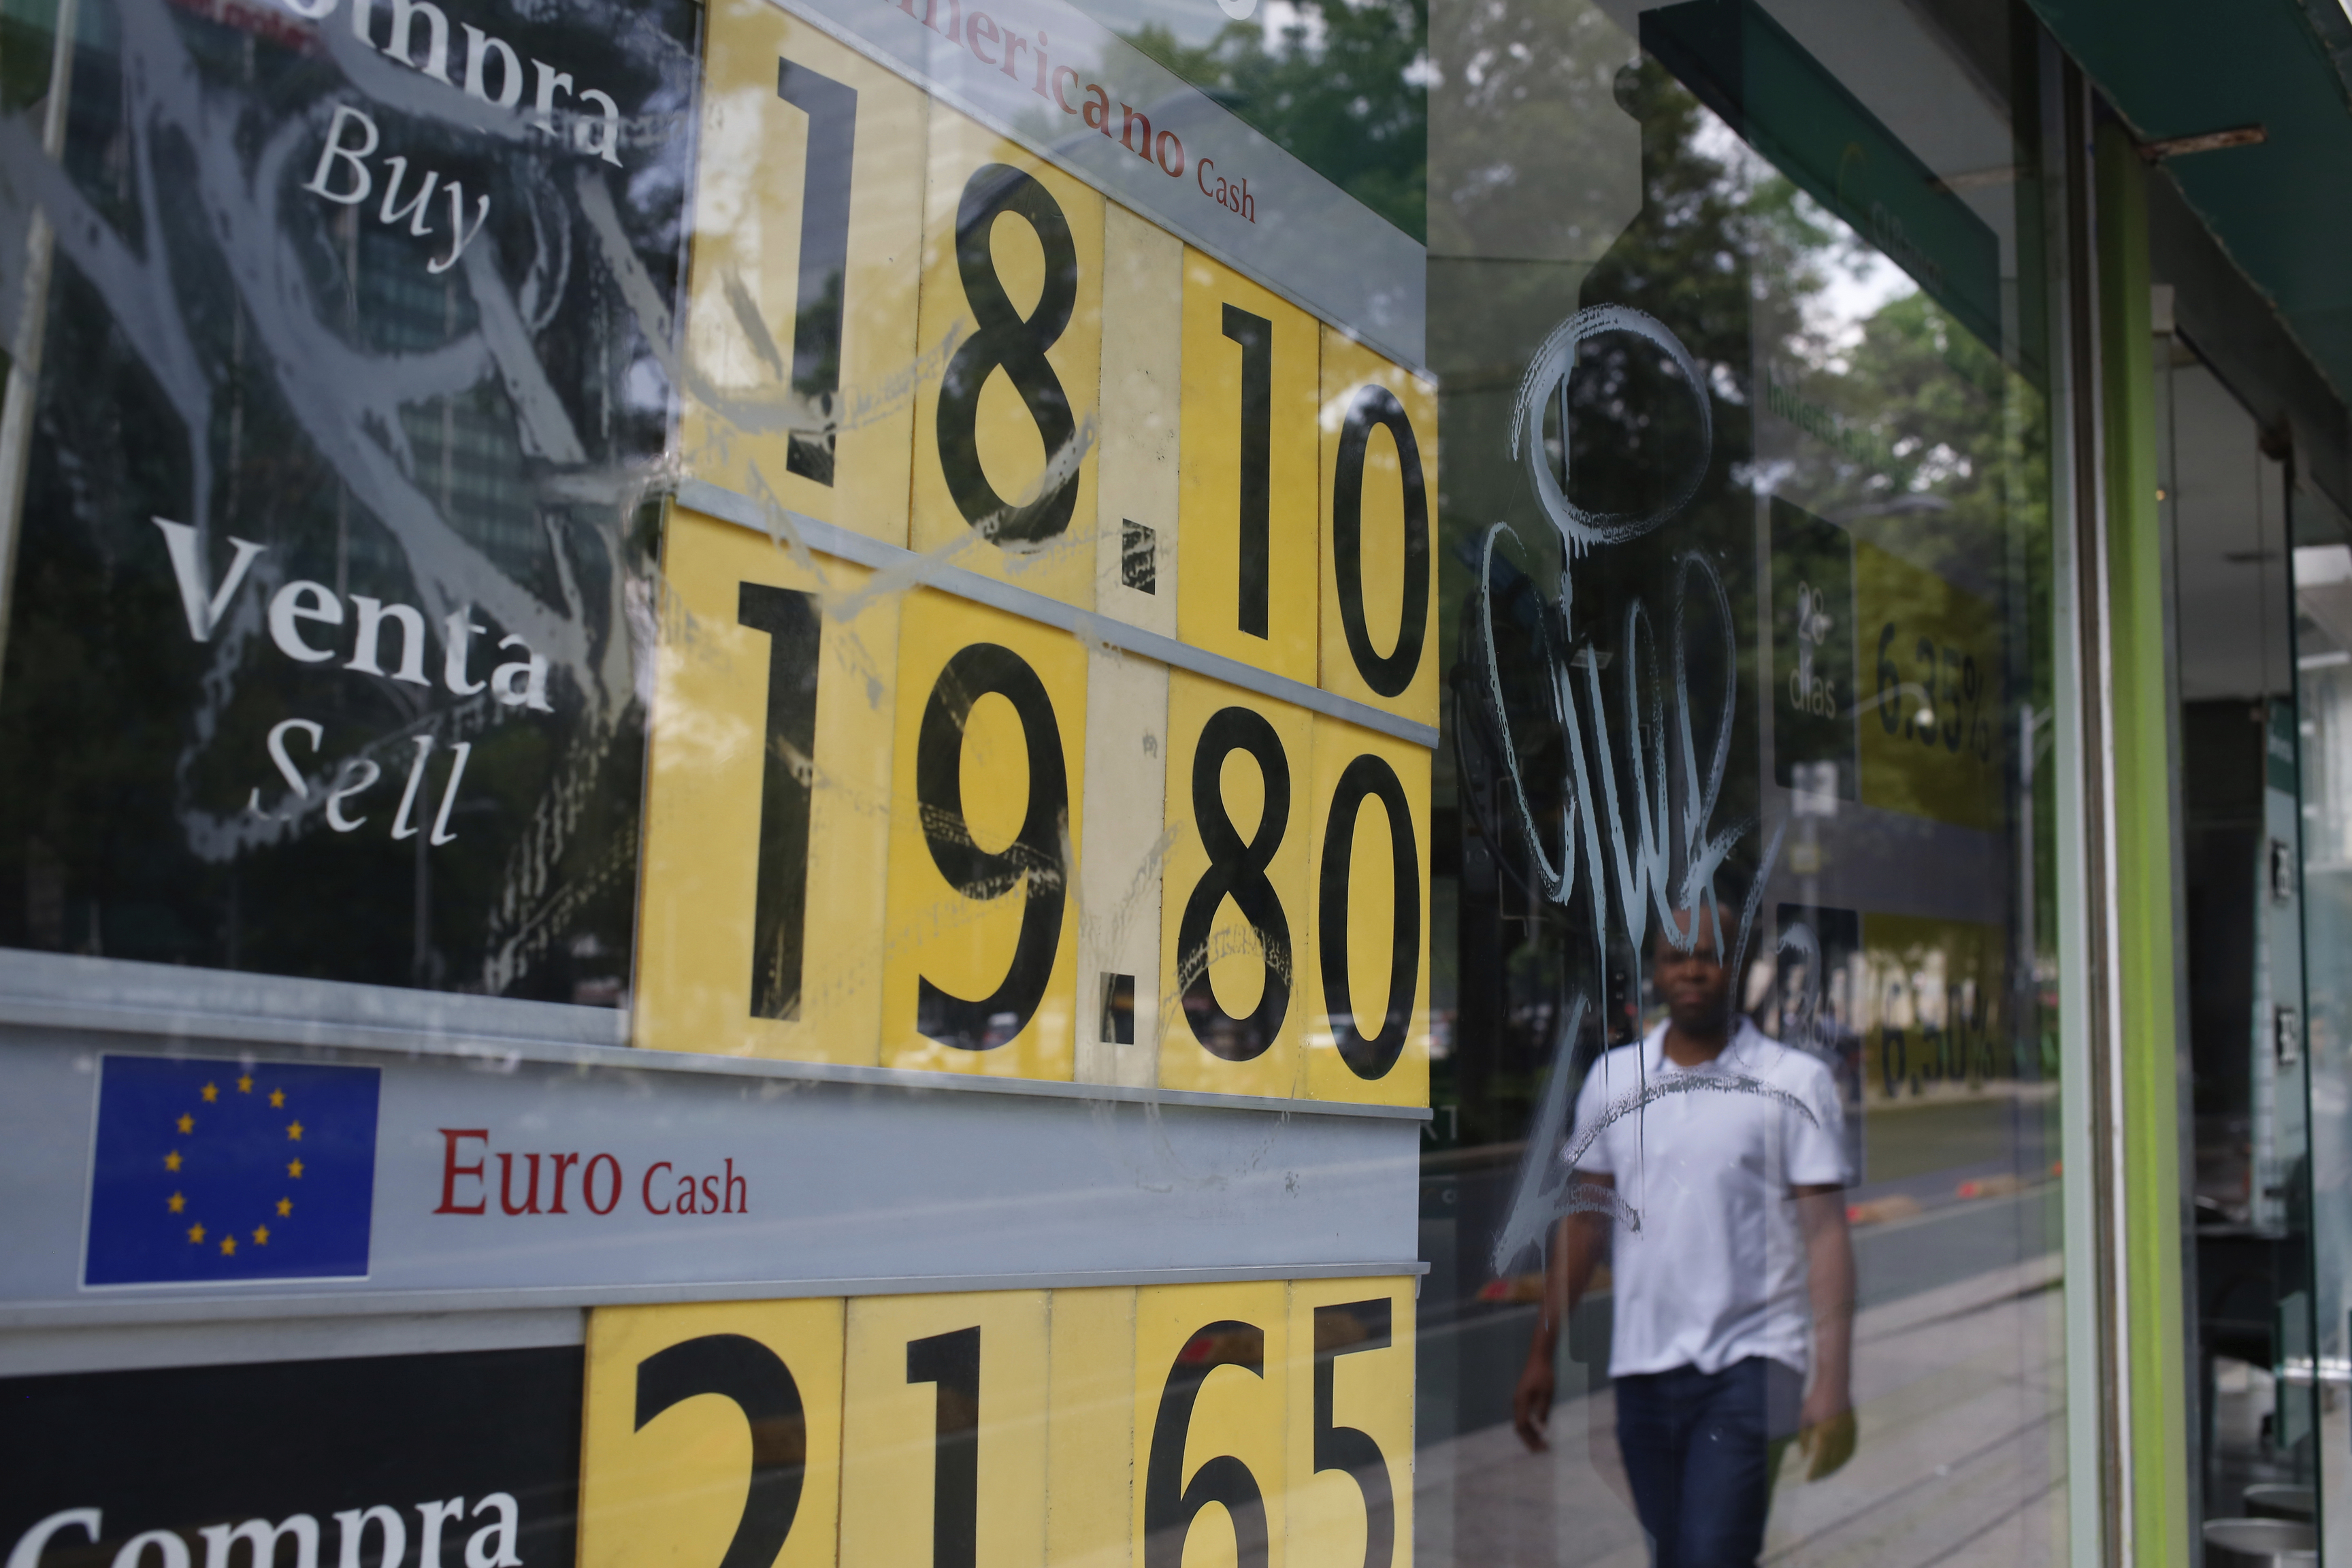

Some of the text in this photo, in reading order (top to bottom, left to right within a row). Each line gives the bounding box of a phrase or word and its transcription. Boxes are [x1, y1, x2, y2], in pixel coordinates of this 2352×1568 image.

[278, 0, 623, 168] mpra
[304, 104, 490, 274] Buy
[1197, 157, 1256, 224] Cash
[777, 56, 1430, 698] 18.10
[152, 516, 555, 713] Venta
[248, 717, 472, 847] Sell
[738, 581, 1421, 1081] 19.80
[432, 1128, 749, 1217] Euro Cash
